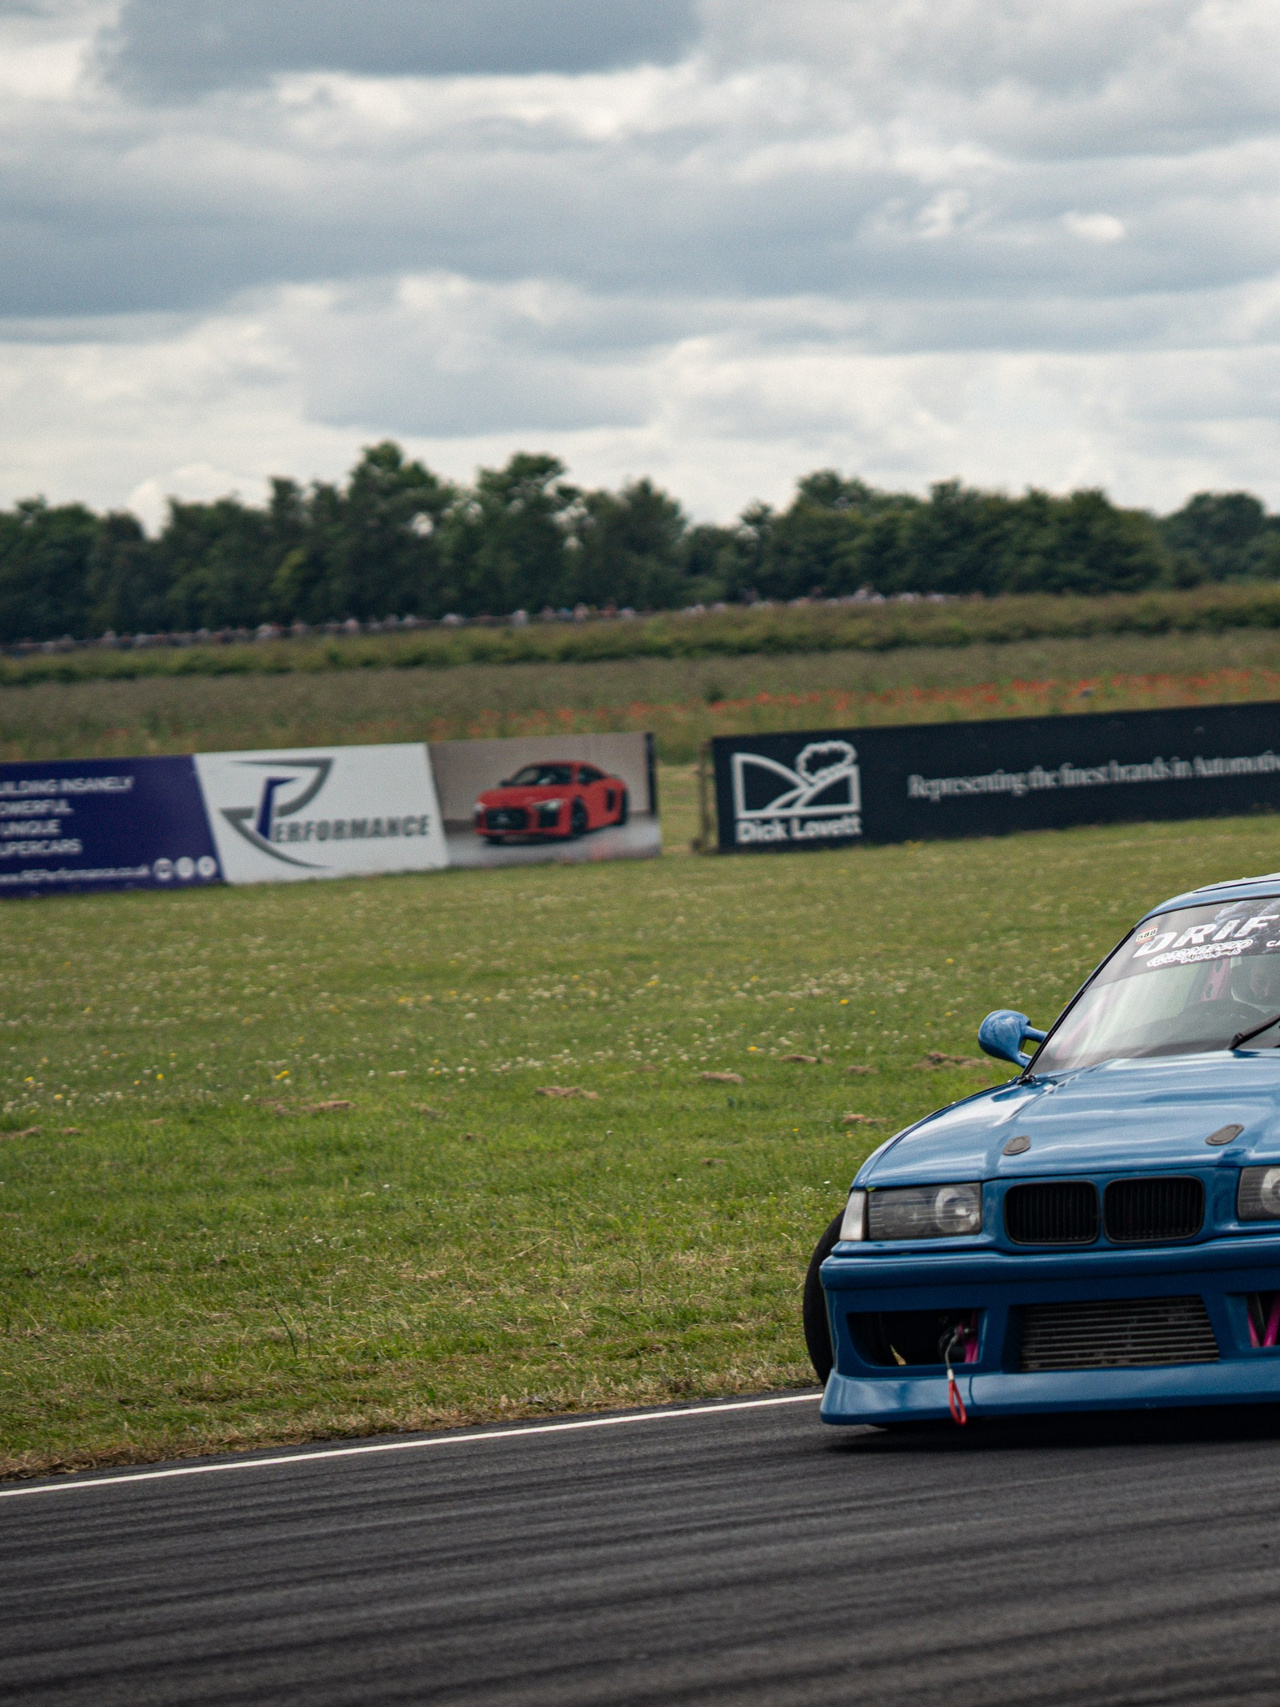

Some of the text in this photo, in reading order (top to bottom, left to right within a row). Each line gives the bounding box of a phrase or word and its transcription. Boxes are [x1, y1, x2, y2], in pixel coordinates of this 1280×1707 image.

[906, 768, 1028, 802] Representing
[1028, 765, 1059, 791] the
[1059, 762, 1109, 788] finest
[1109, 756, 1171, 784] brands
[1171, 756, 1192, 779] in
[736, 814, 863, 843] Dick Lovett
